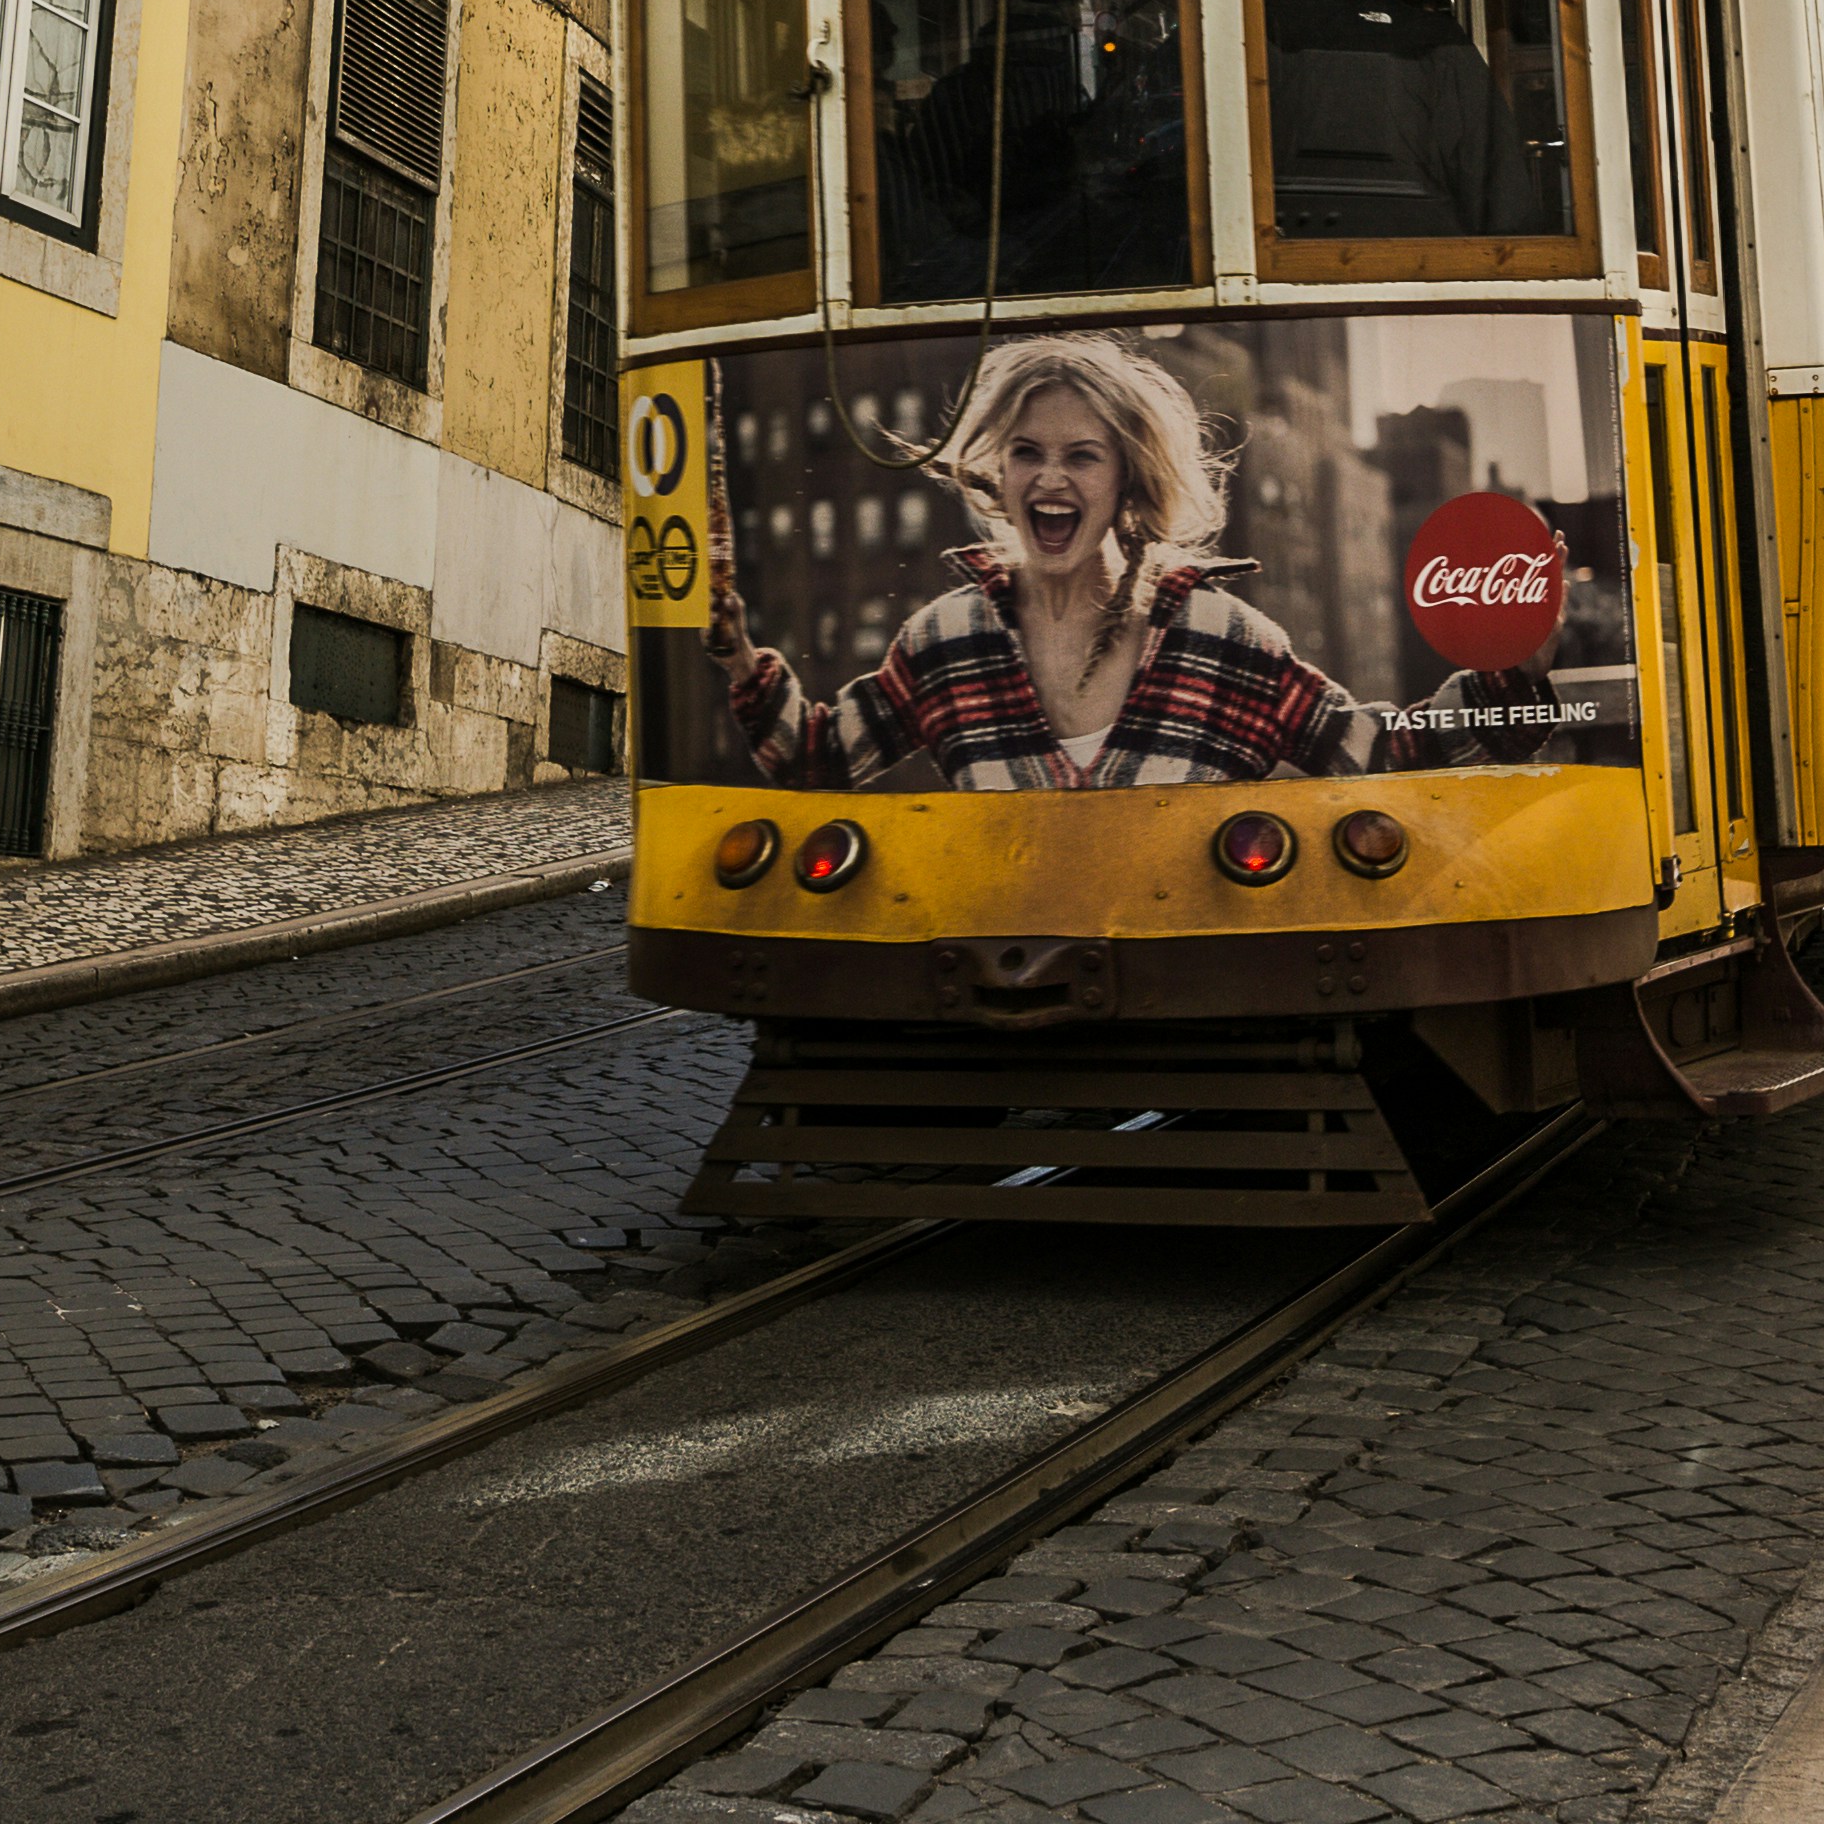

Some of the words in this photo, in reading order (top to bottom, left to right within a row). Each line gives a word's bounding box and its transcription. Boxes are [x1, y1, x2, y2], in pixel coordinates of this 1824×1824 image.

[1413, 553, 1555, 608] Coca-Cola
[1381, 709, 1456, 731] TASTE
[1459, 706, 1504, 728] THE
[1509, 701, 1597, 726] FEELING
